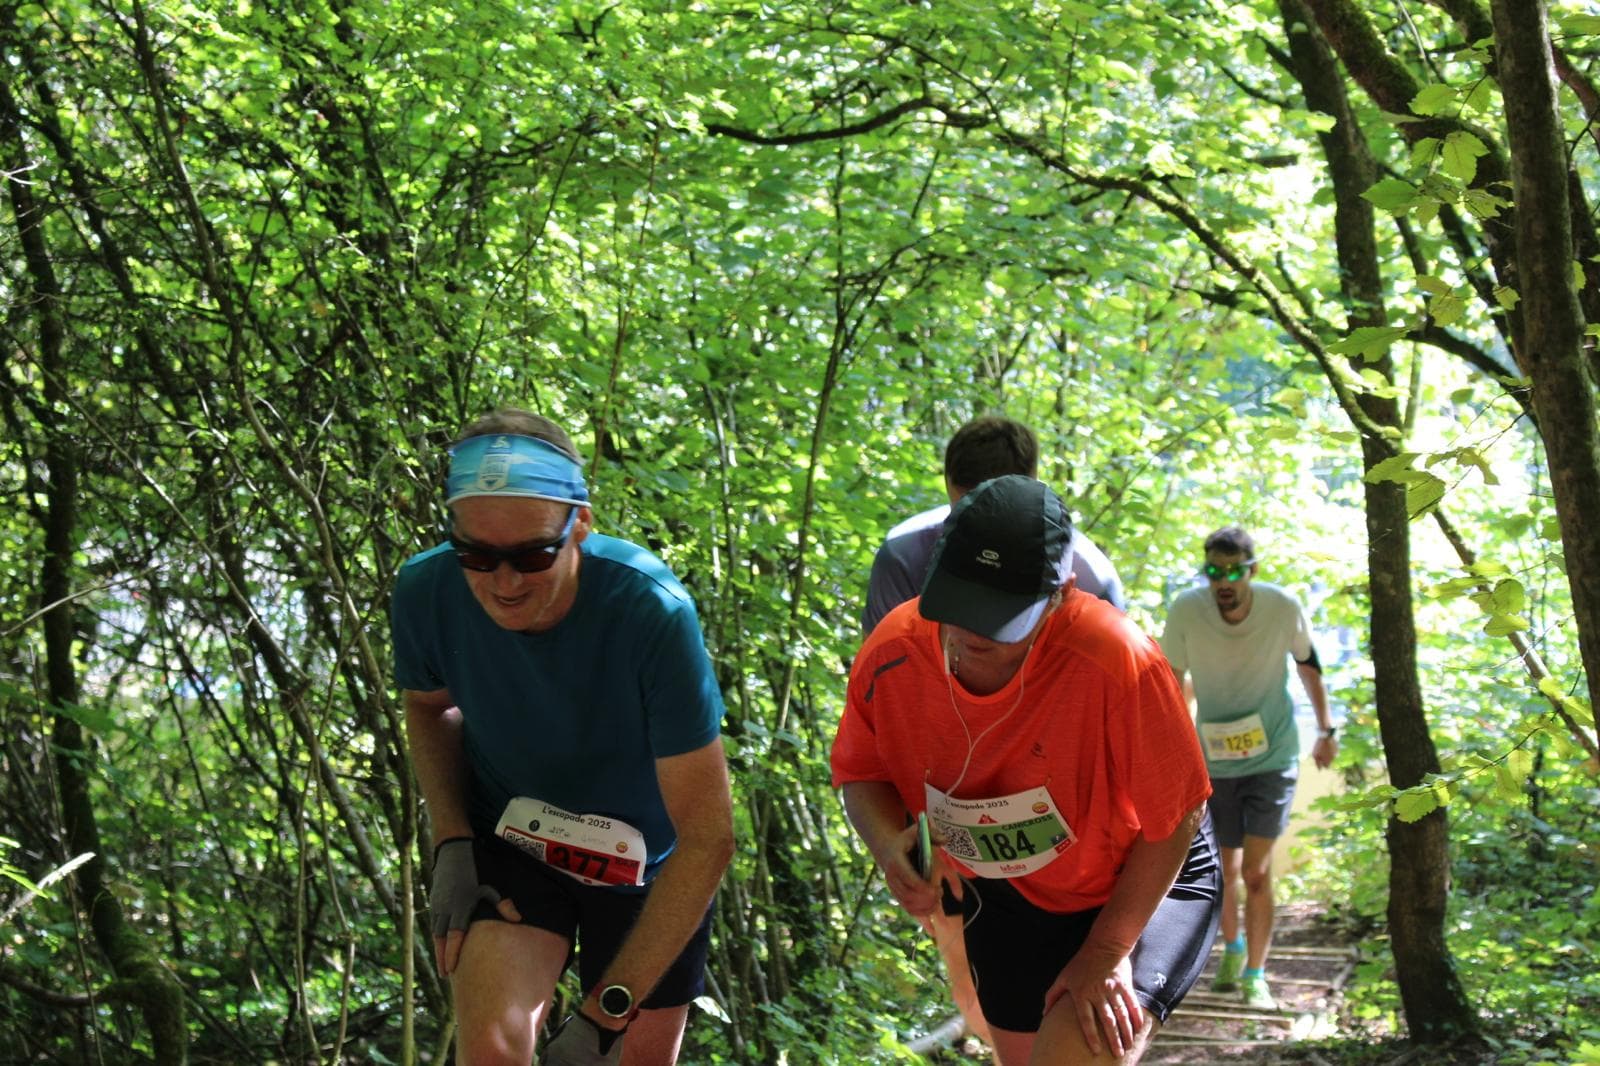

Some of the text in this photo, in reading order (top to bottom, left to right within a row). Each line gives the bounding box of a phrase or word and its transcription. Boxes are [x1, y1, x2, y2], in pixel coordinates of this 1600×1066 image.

[1226, 733, 1253, 751] 126
[986, 800, 1009, 809] 2025
[541, 805, 612, 830] L'escapade 2025
[1001, 815, 1053, 831] CANICROSS
[979, 830, 1036, 861] 184
